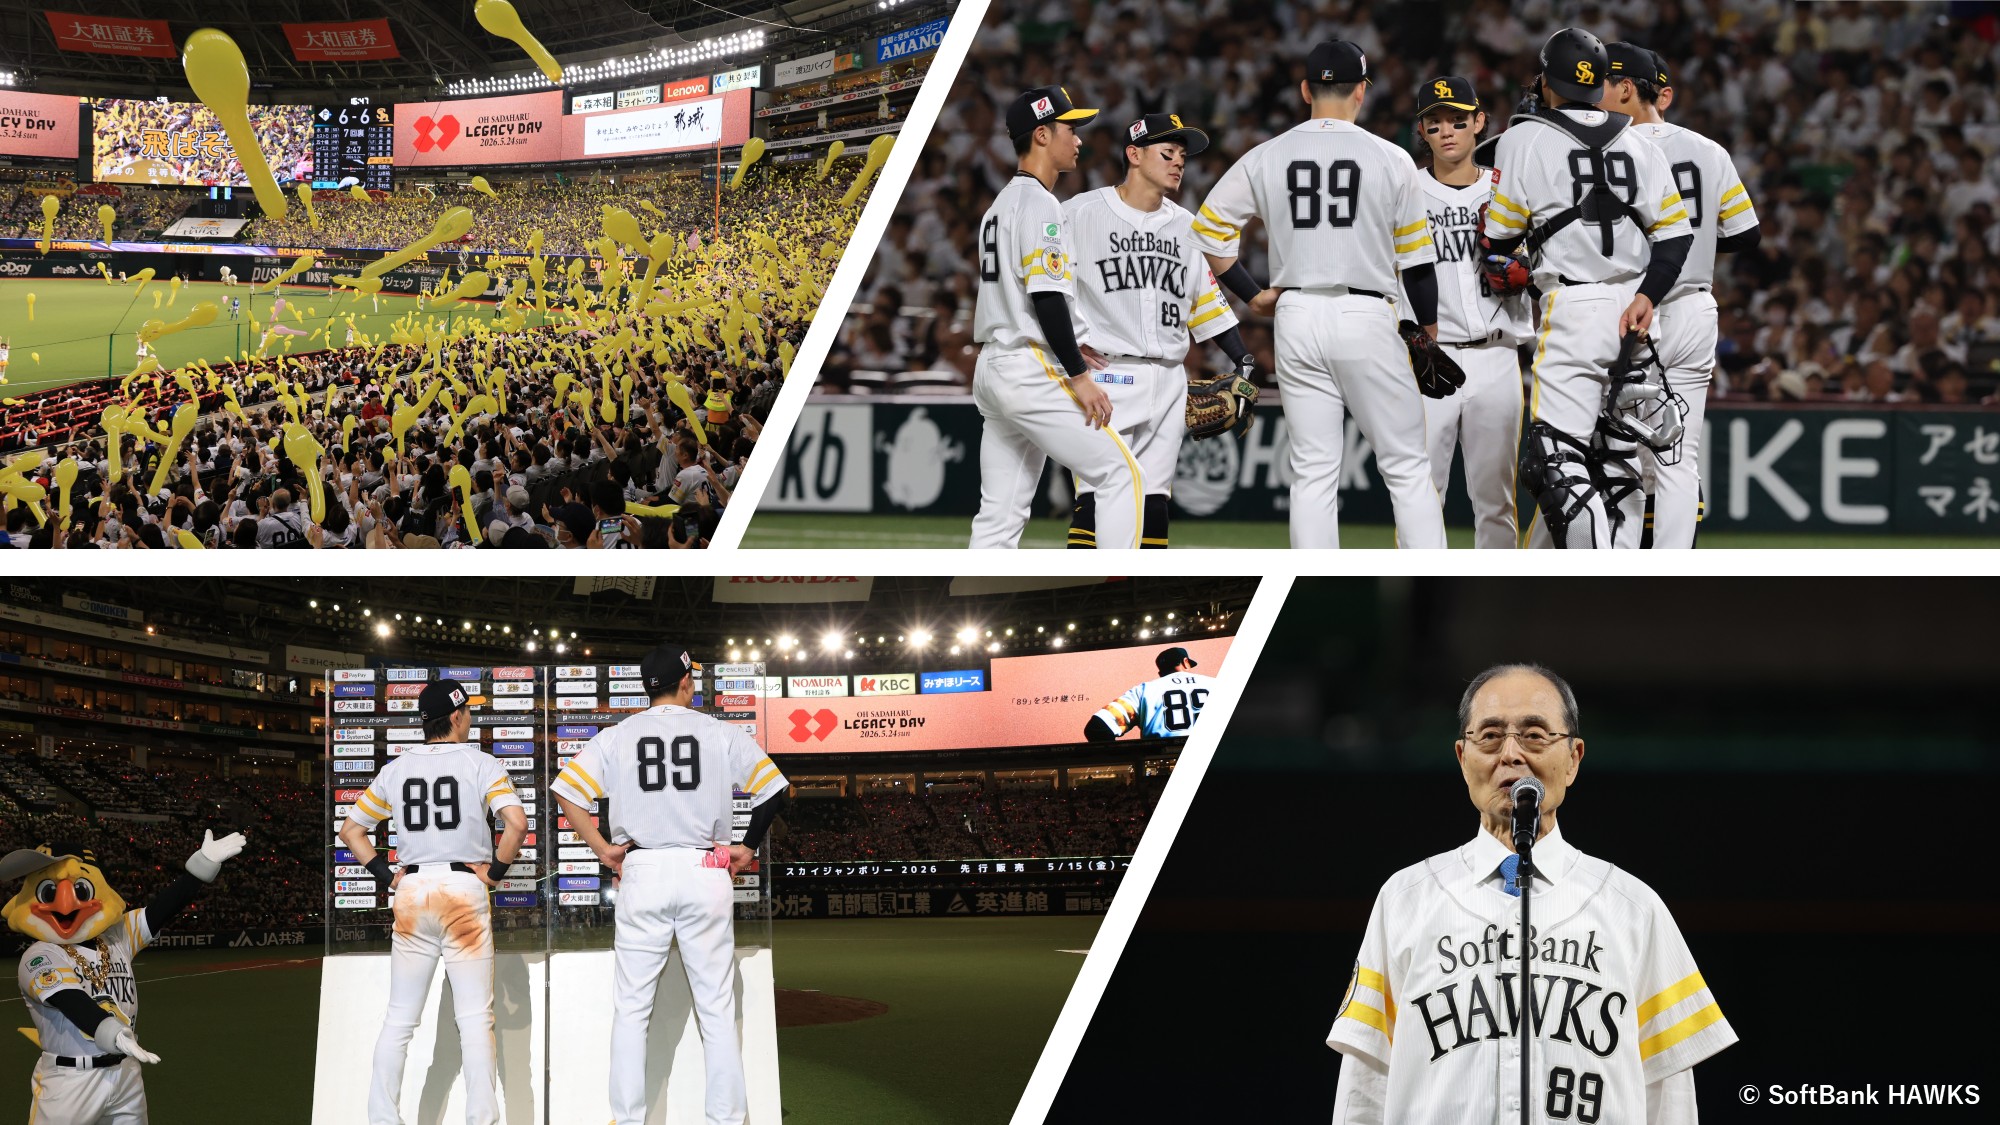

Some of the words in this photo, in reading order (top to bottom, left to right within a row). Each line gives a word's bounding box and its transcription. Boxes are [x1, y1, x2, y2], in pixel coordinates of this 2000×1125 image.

[69, 21, 154, 42] 大和証券
[303, 29, 377, 48] 大和証券
[881, 31, 944, 60] AMANO
[583, 97, 612, 109] 森本組
[26, 118, 55, 130] DAY
[339, 109, 348, 124] 6
[360, 109, 369, 124] 6
[478, 113, 489, 123] OH
[491, 113, 530, 123] SADAHARU
[465, 123, 514, 138] LEGACY
[517, 121, 543, 135] DAY
[1287, 159, 1362, 230] 89
[1426, 206, 1479, 229] SoftBa
[52, 242, 91, 250] HAWKS
[178, 245, 212, 253] HAWKS
[1110, 230, 1181, 258] SoftBank
[292, 248, 324, 256] HAWKS
[1096, 254, 1188, 299] HAWKS
[1161, 301, 1181, 328] 89
[10, 583, 31, 594] trans
[10, 591, 42, 602] cosmos
[90, 602, 128, 618] ONOKEN
[792, 678, 842, 688] NOMURA
[880, 679, 910, 691] KBC
[924, 676, 981, 689] みずほリース
[37, 705, 62, 715] NIC
[346, 702, 372, 710] 大東建託
[870, 709, 912, 718] SADAHARU
[844, 717, 896, 730] LEGACY
[900, 717, 926, 728] DAY
[504, 759, 532, 767] 大東建託
[637, 735, 701, 793] 89
[402, 776, 461, 832] 89
[901, 866, 937, 874] 2026
[960, 863, 1024, 873] 先行販売
[510, 881, 528, 889] PayPay
[828, 892, 931, 916] 西部電気工業
[976, 892, 1048, 912] 英進館
[256, 931, 306, 947] JA共済
[336, 927, 366, 942] Denka
[1437, 922, 1604, 975] SoftBank
[1410, 972, 1627, 1064] HAWKS
[1545, 1065, 1604, 1125] 89
